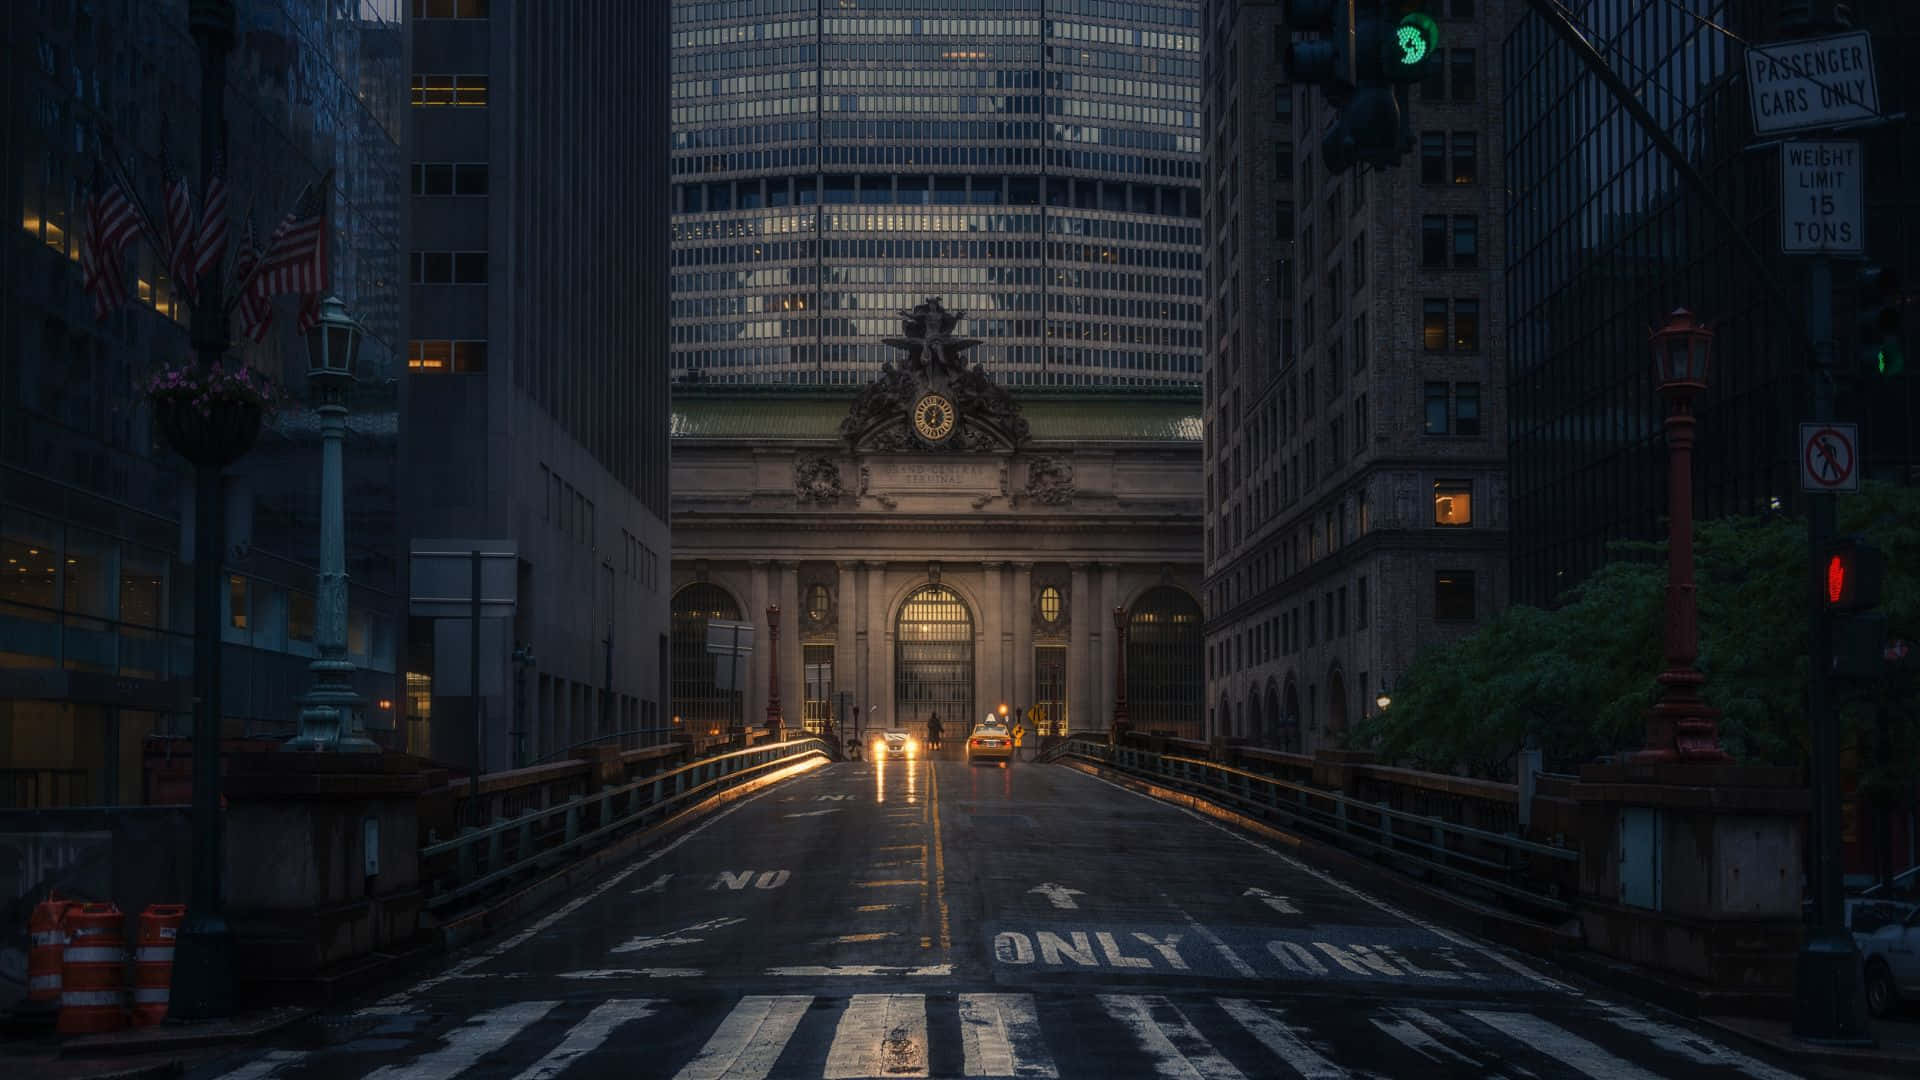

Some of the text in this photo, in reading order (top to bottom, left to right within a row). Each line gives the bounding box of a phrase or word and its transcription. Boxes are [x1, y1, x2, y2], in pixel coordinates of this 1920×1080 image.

[1756, 47, 1863, 83] PASSENGER
[1760, 80, 1866, 117] CARS ONLY
[1790, 149, 1854, 166] WEIGHT
[1799, 172, 1845, 188] LIMIT
[1810, 195, 1834, 215] 15
[1794, 222, 1852, 242] TONS
[994, 930, 1191, 971] ONLY
